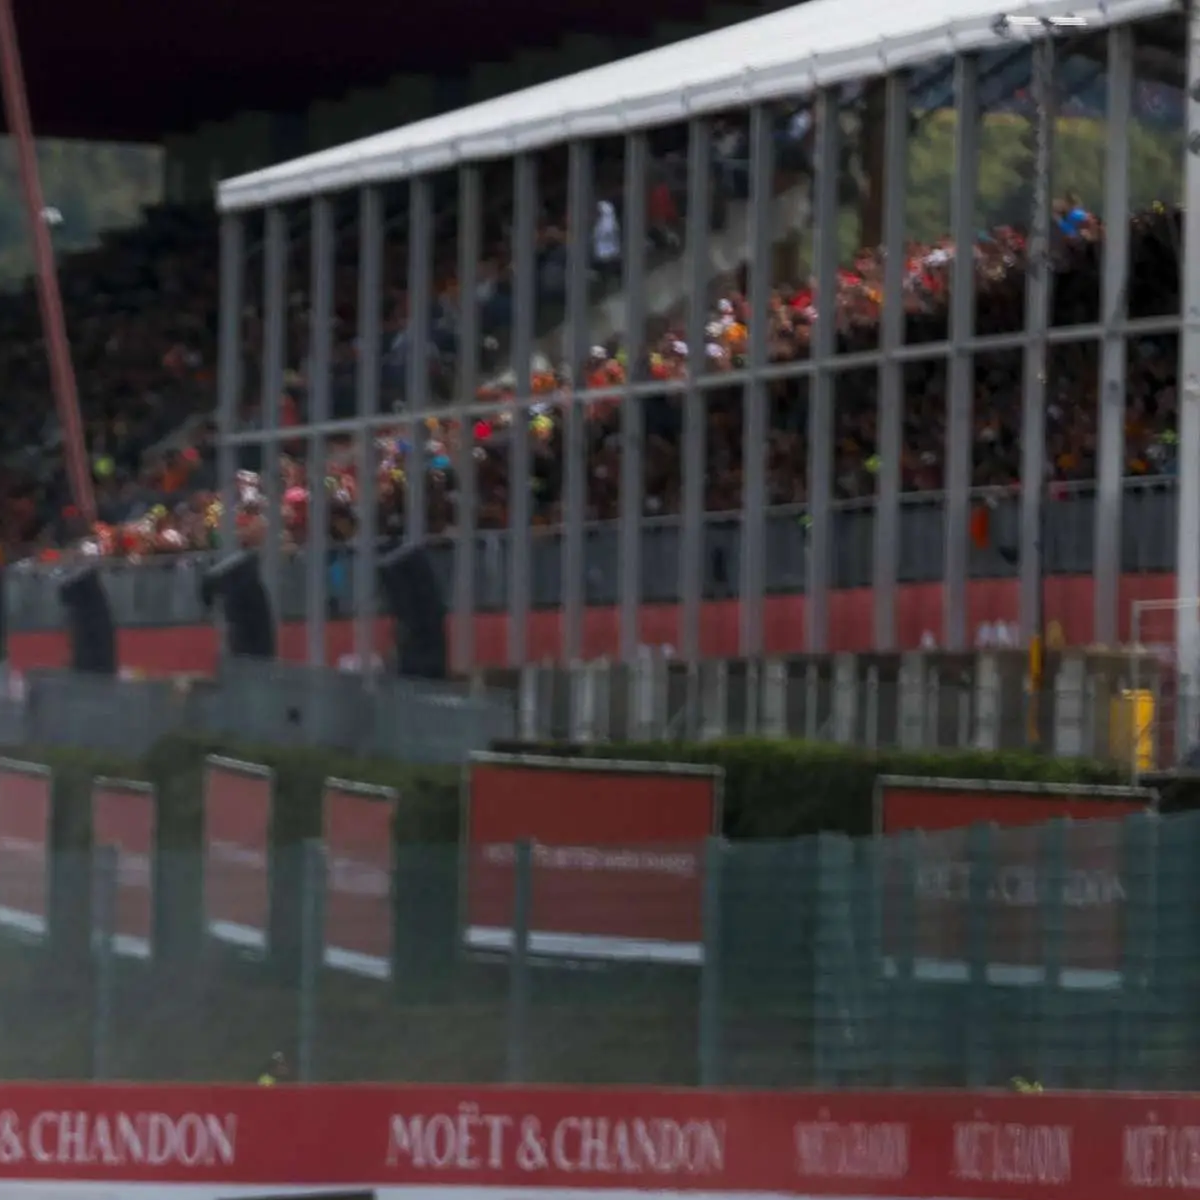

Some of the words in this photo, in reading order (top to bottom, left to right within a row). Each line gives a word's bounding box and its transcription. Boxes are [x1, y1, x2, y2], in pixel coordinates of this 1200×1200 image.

[29, 1110, 237, 1167] CHANDON
[386, 1101, 512, 1168] MOËT
[516, 1114, 547, 1170] &
[553, 1116, 725, 1172] CHANDON
